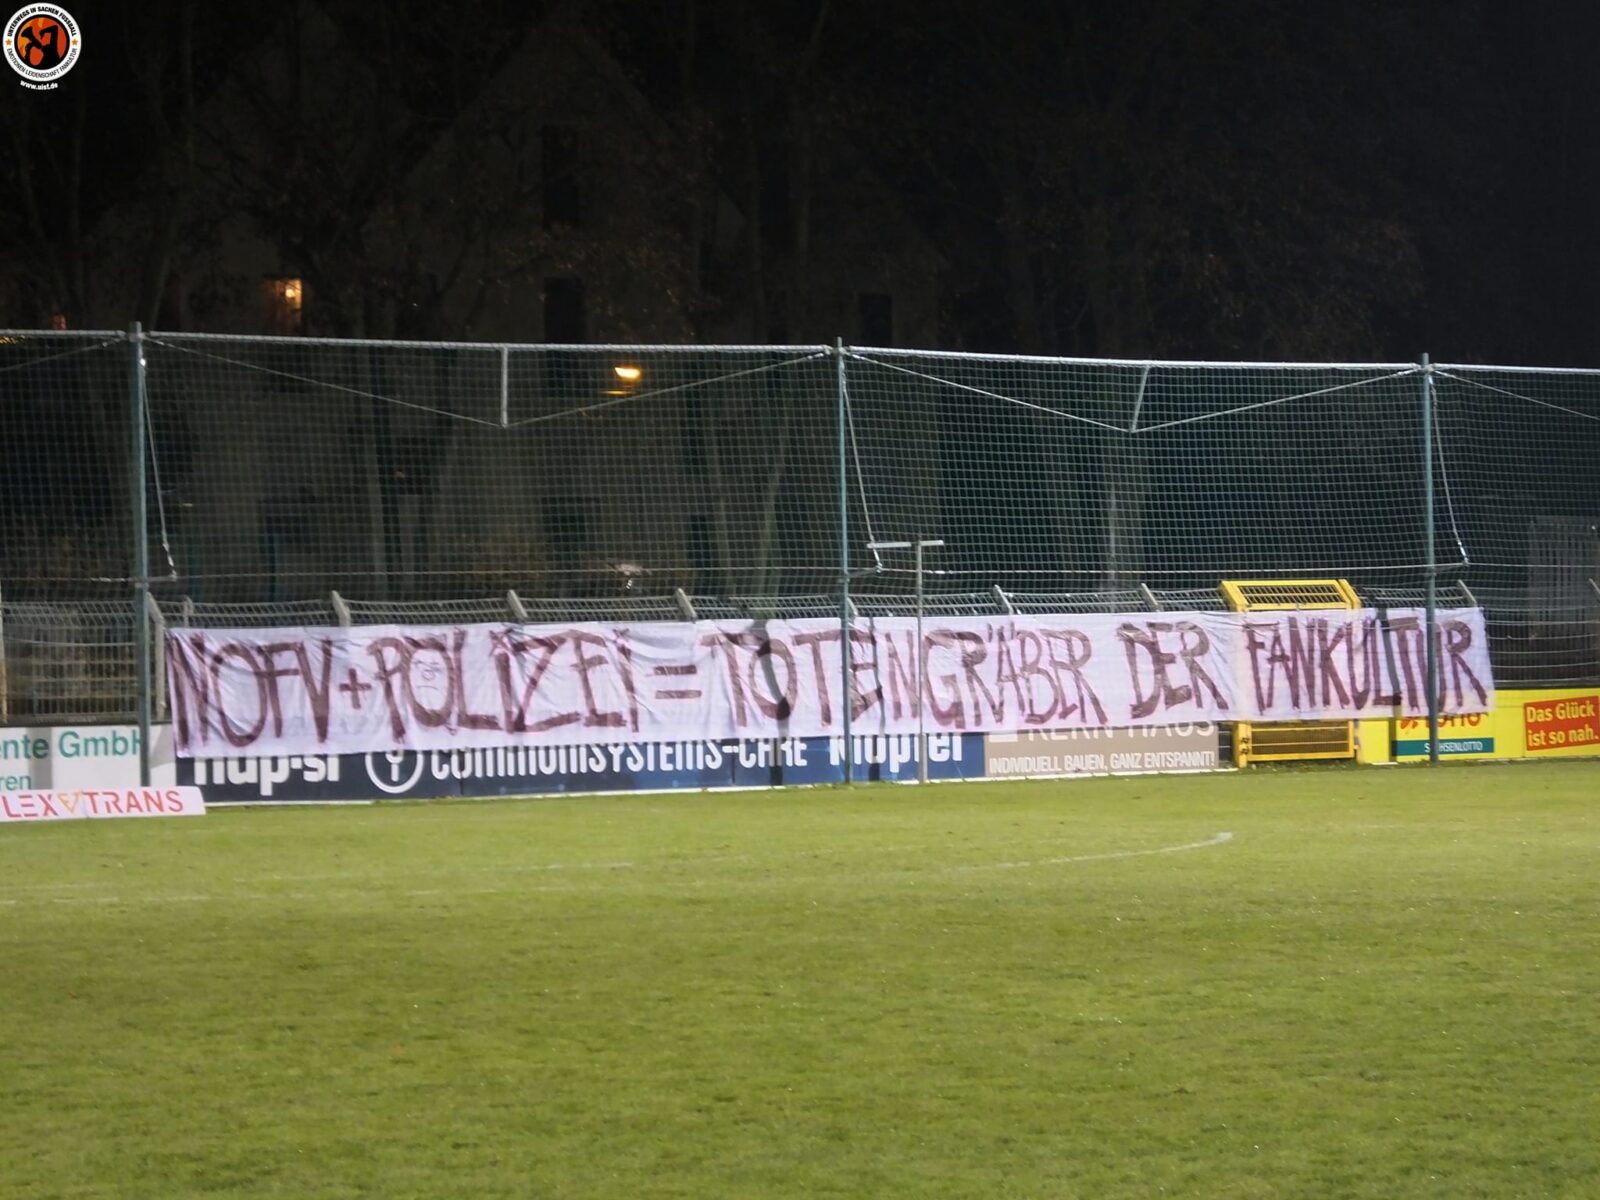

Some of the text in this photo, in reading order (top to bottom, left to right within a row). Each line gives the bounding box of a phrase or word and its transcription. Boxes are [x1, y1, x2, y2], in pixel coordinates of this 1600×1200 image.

[1117, 621, 1229, 719] DER
[1244, 615, 1487, 716] FANKULTUR
[1526, 701, 1596, 723] Das Glück
[0, 729, 141, 760] nte GmbH
[1527, 724, 1600, 747] ist so nah.
[989, 750, 1215, 774] INDIVIDUELL BAUEN, GANZ ENTSPANNT!
